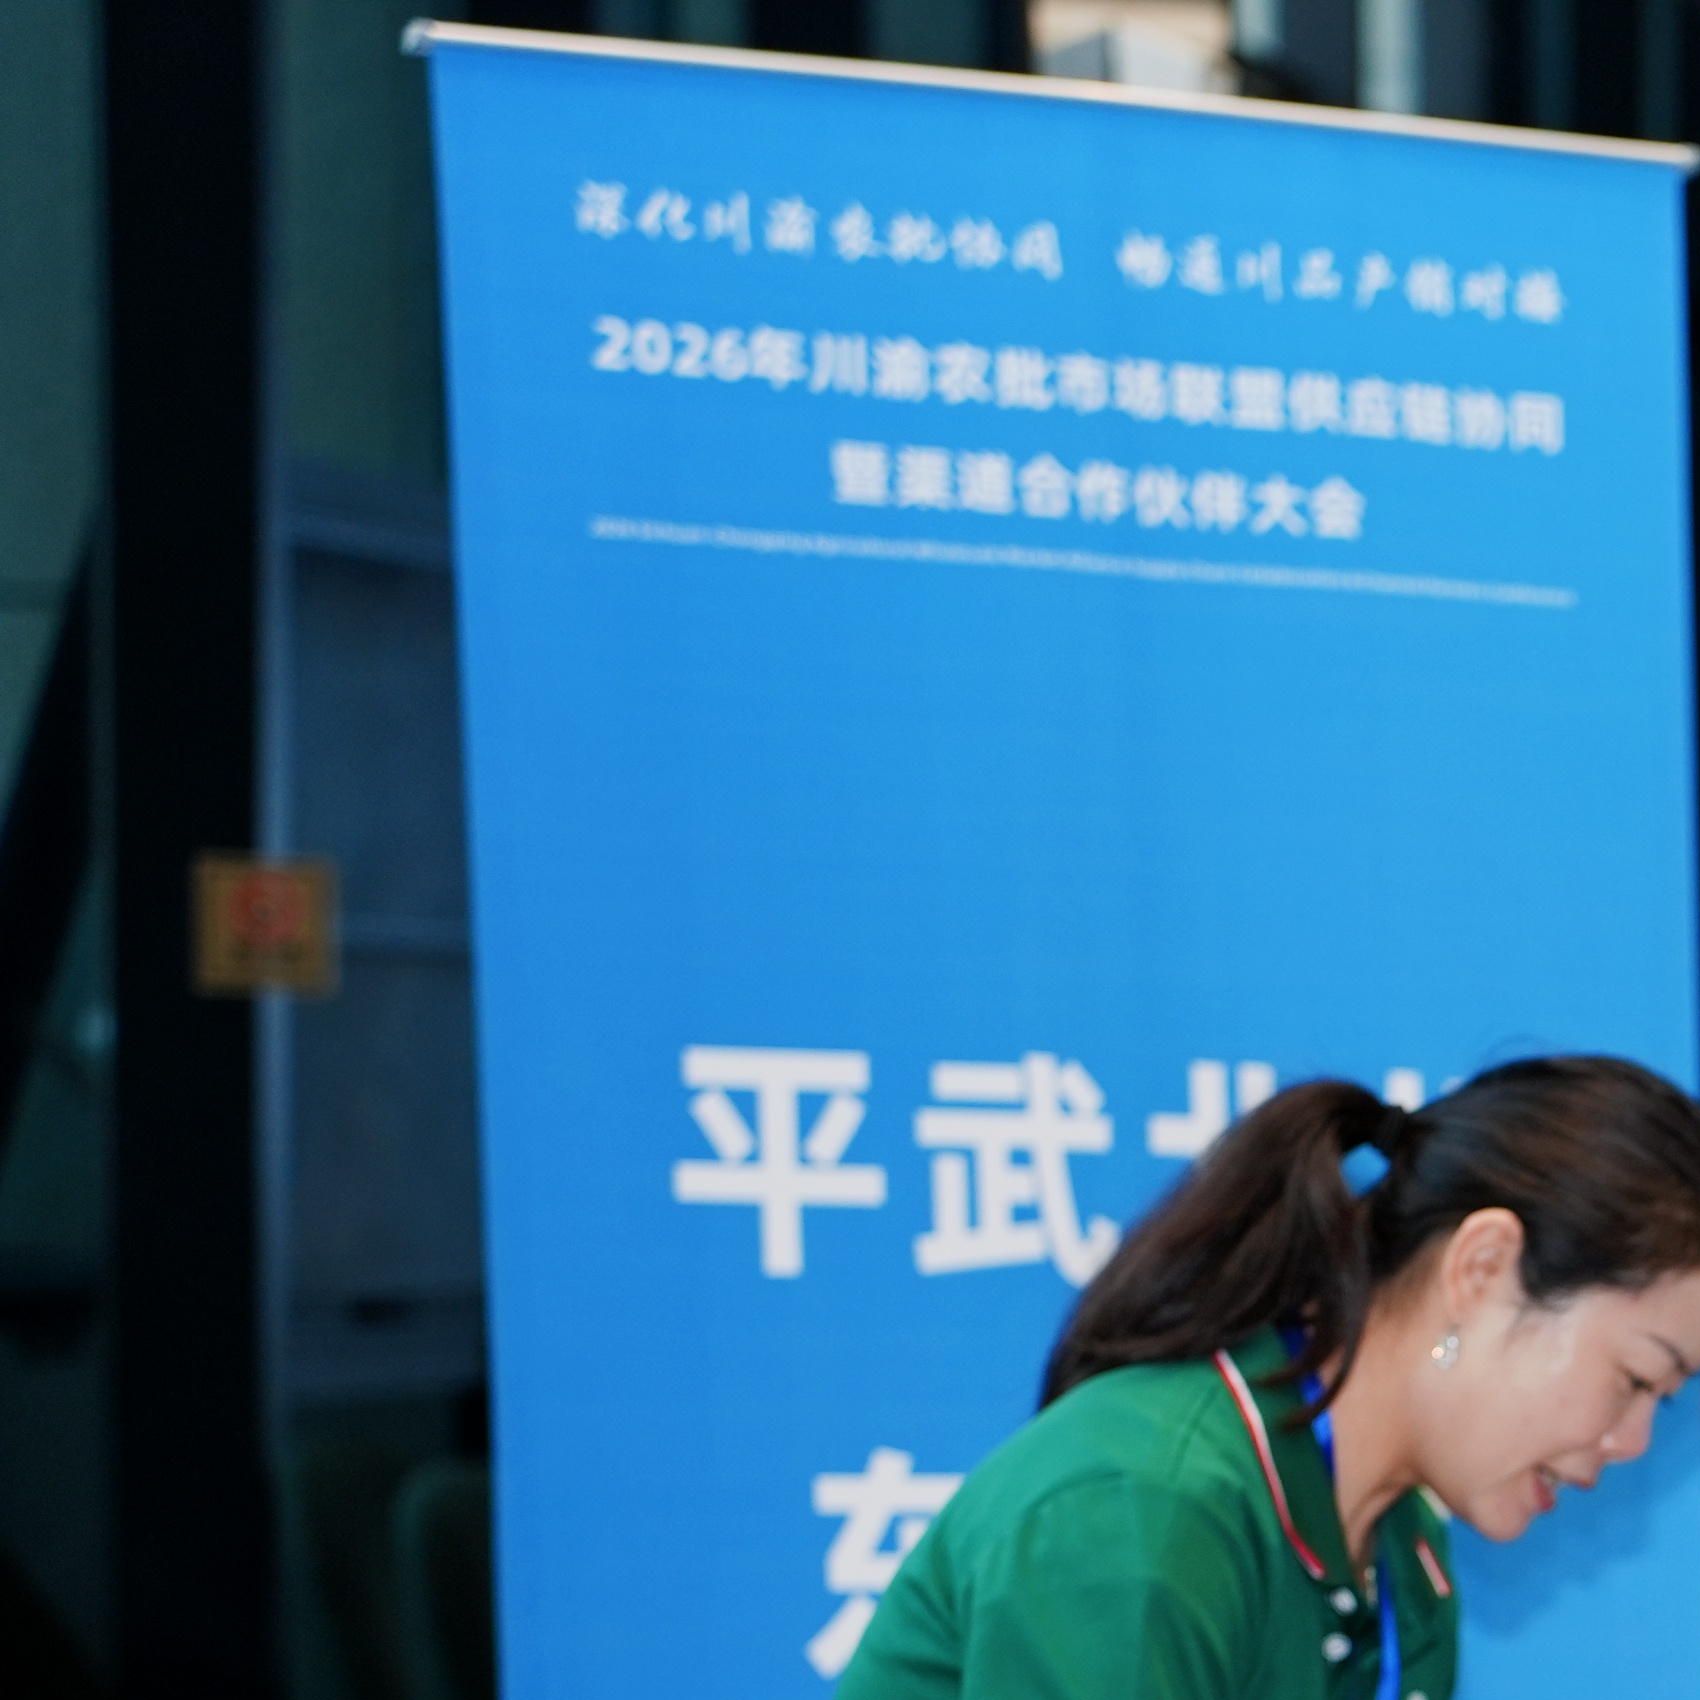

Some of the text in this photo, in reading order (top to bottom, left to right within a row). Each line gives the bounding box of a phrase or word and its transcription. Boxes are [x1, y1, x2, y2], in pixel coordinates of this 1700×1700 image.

[590, 312, 1567, 457] 2026年川渝农批市场联盟供应链协同
[828, 438, 1368, 542] 暨渠道合作伙伴大会
